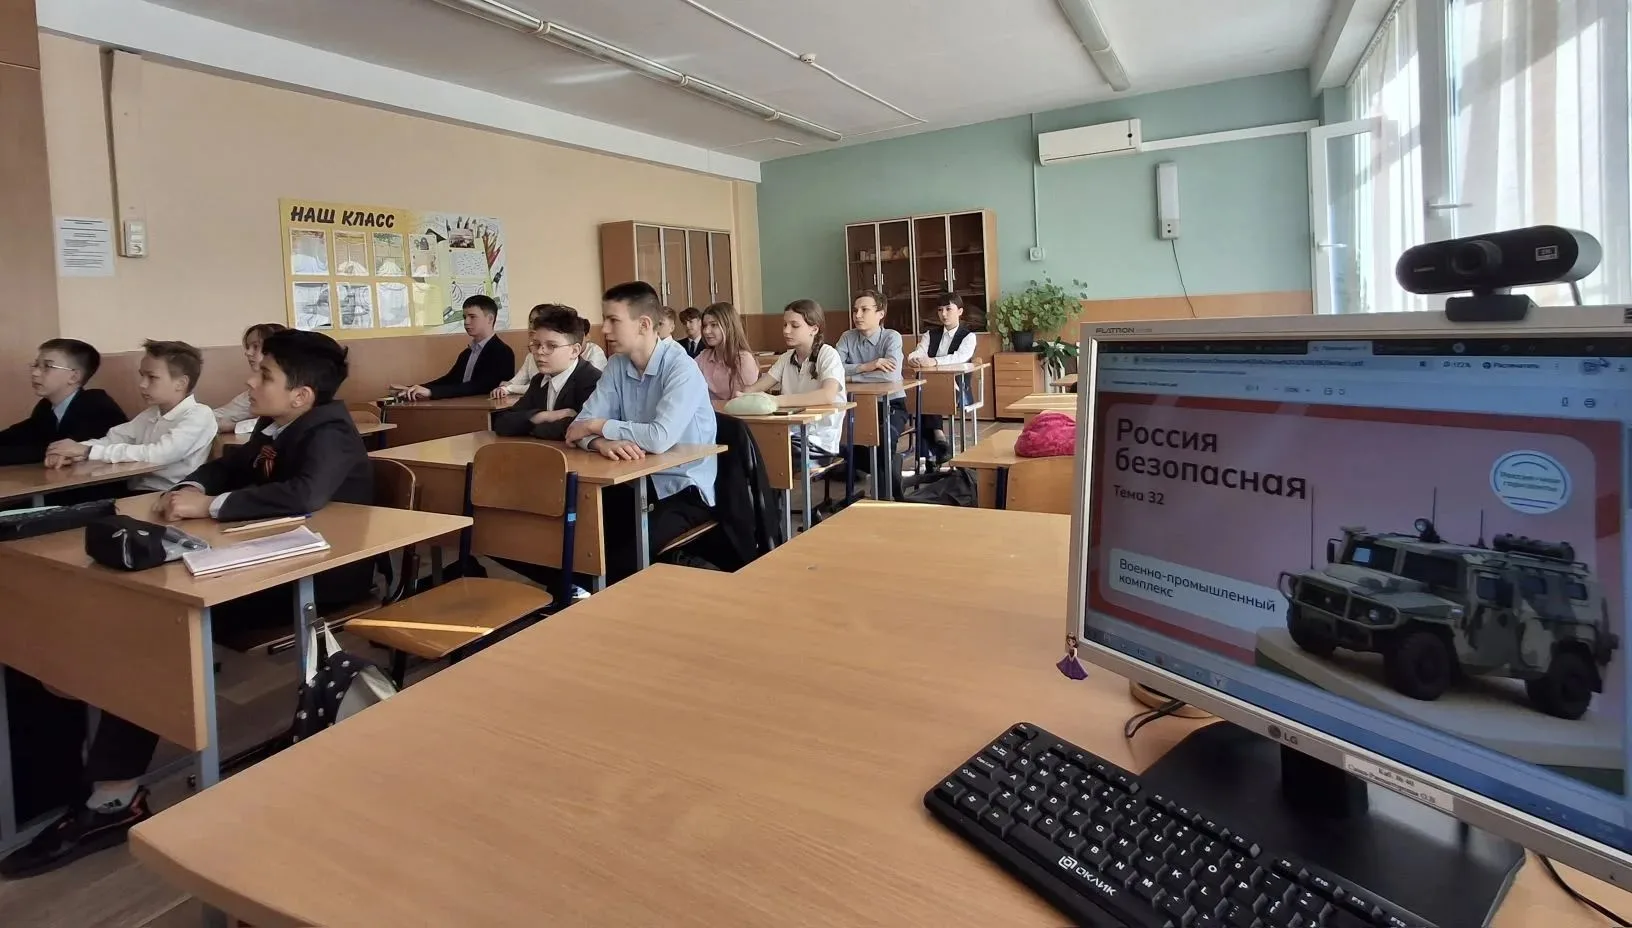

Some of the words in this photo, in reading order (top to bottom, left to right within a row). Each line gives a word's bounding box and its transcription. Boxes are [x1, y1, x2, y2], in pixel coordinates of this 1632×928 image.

[290, 206, 335, 224] НАШ
[341, 210, 395, 228] КЛАСС
[1116, 418, 1217, 453] Россия
[1115, 447, 1306, 500] безопасная
[1113, 484, 1144, 501] Тема
[1148, 491, 1165, 505] 32
[1119, 558, 1276, 613] Военно-промышленный
[1119, 574, 1175, 598] комплекс
[1283, 732, 1298, 745] LG
[1039, 769, 1048, 777] W
[1002, 791, 1011, 799] Z
[1081, 793, 1090, 801] R
[1023, 804, 1033, 812] X
[1104, 805, 1112, 813] T
[1129, 819, 1137, 827] Y
[1095, 824, 1104, 832] G
[1068, 830, 1076, 838] V
[1154, 834, 1163, 842] U
[1119, 838, 1128, 847] H
[1090, 846, 1099, 854] B
[1115, 861, 1125, 870] N
[1207, 864, 1217, 873] O
[1172, 869, 1182, 878] K
[1142, 878, 1153, 888] M
[1238, 881, 1248, 889] P
[1200, 886, 1208, 895] L
